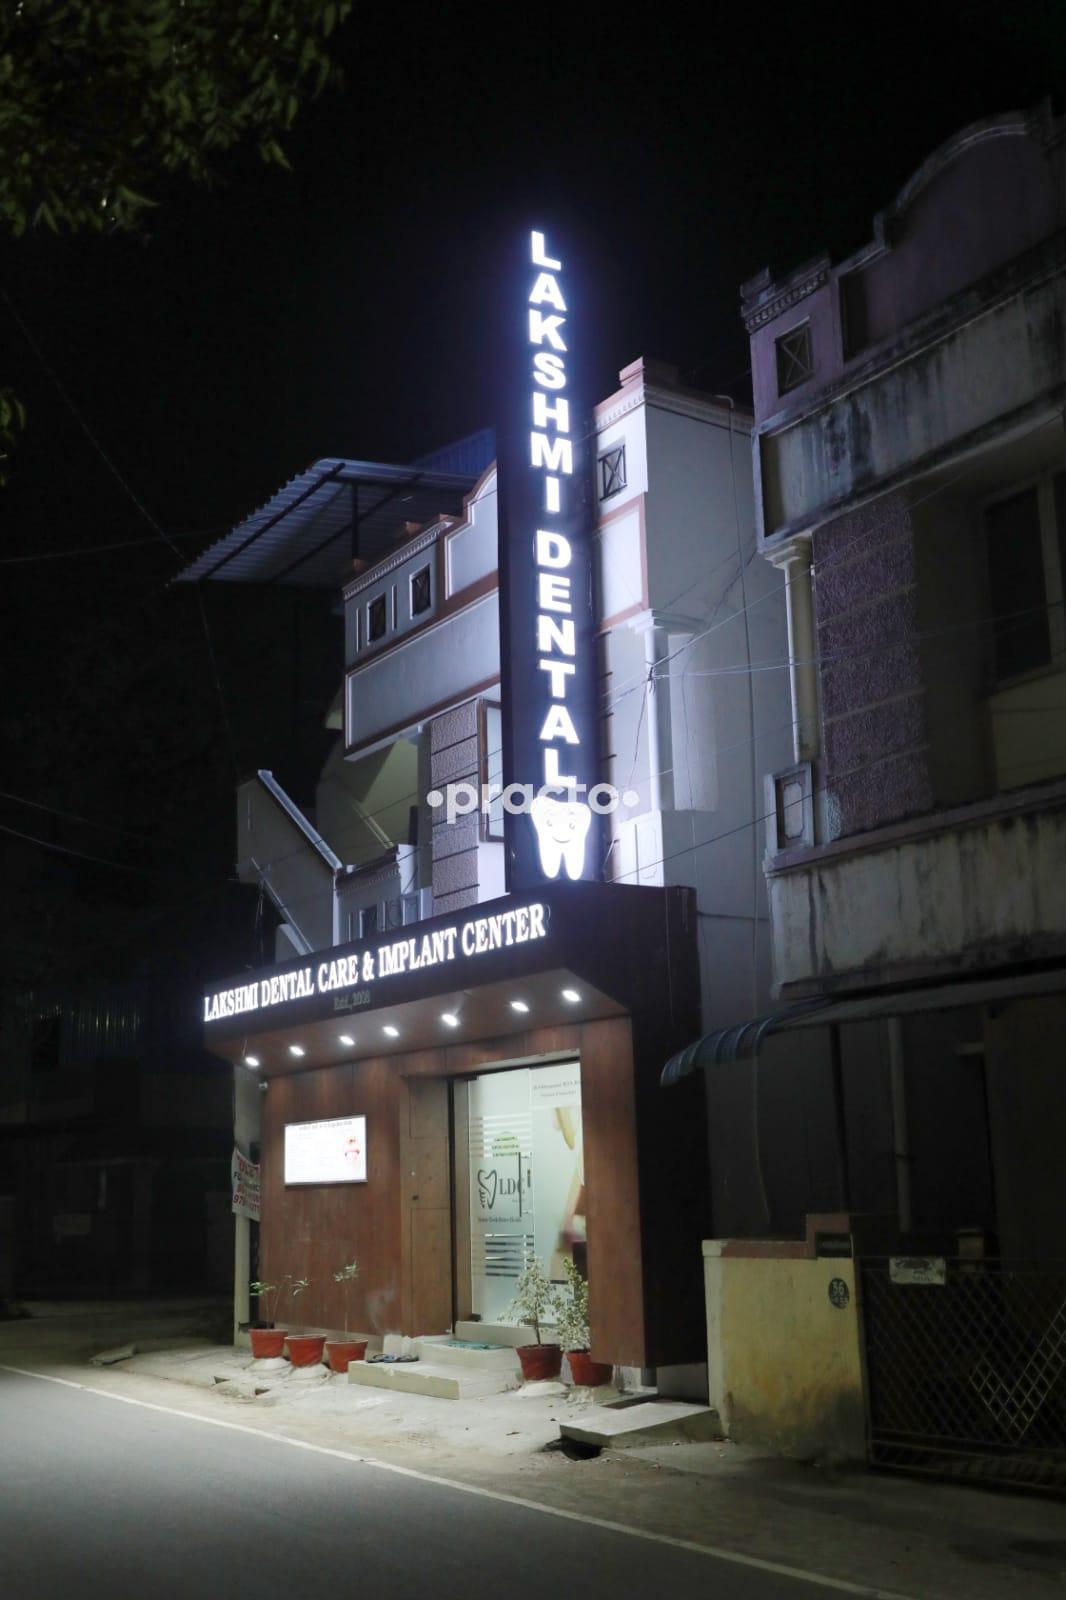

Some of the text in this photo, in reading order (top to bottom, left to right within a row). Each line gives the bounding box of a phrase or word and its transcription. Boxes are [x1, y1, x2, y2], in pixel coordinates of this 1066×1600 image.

[529, 231, 581, 789] LAKSHMI DENTAL
[204, 903, 546, 1022] LAKSHMI DENTAL CARE & IMPLANT CENTER
